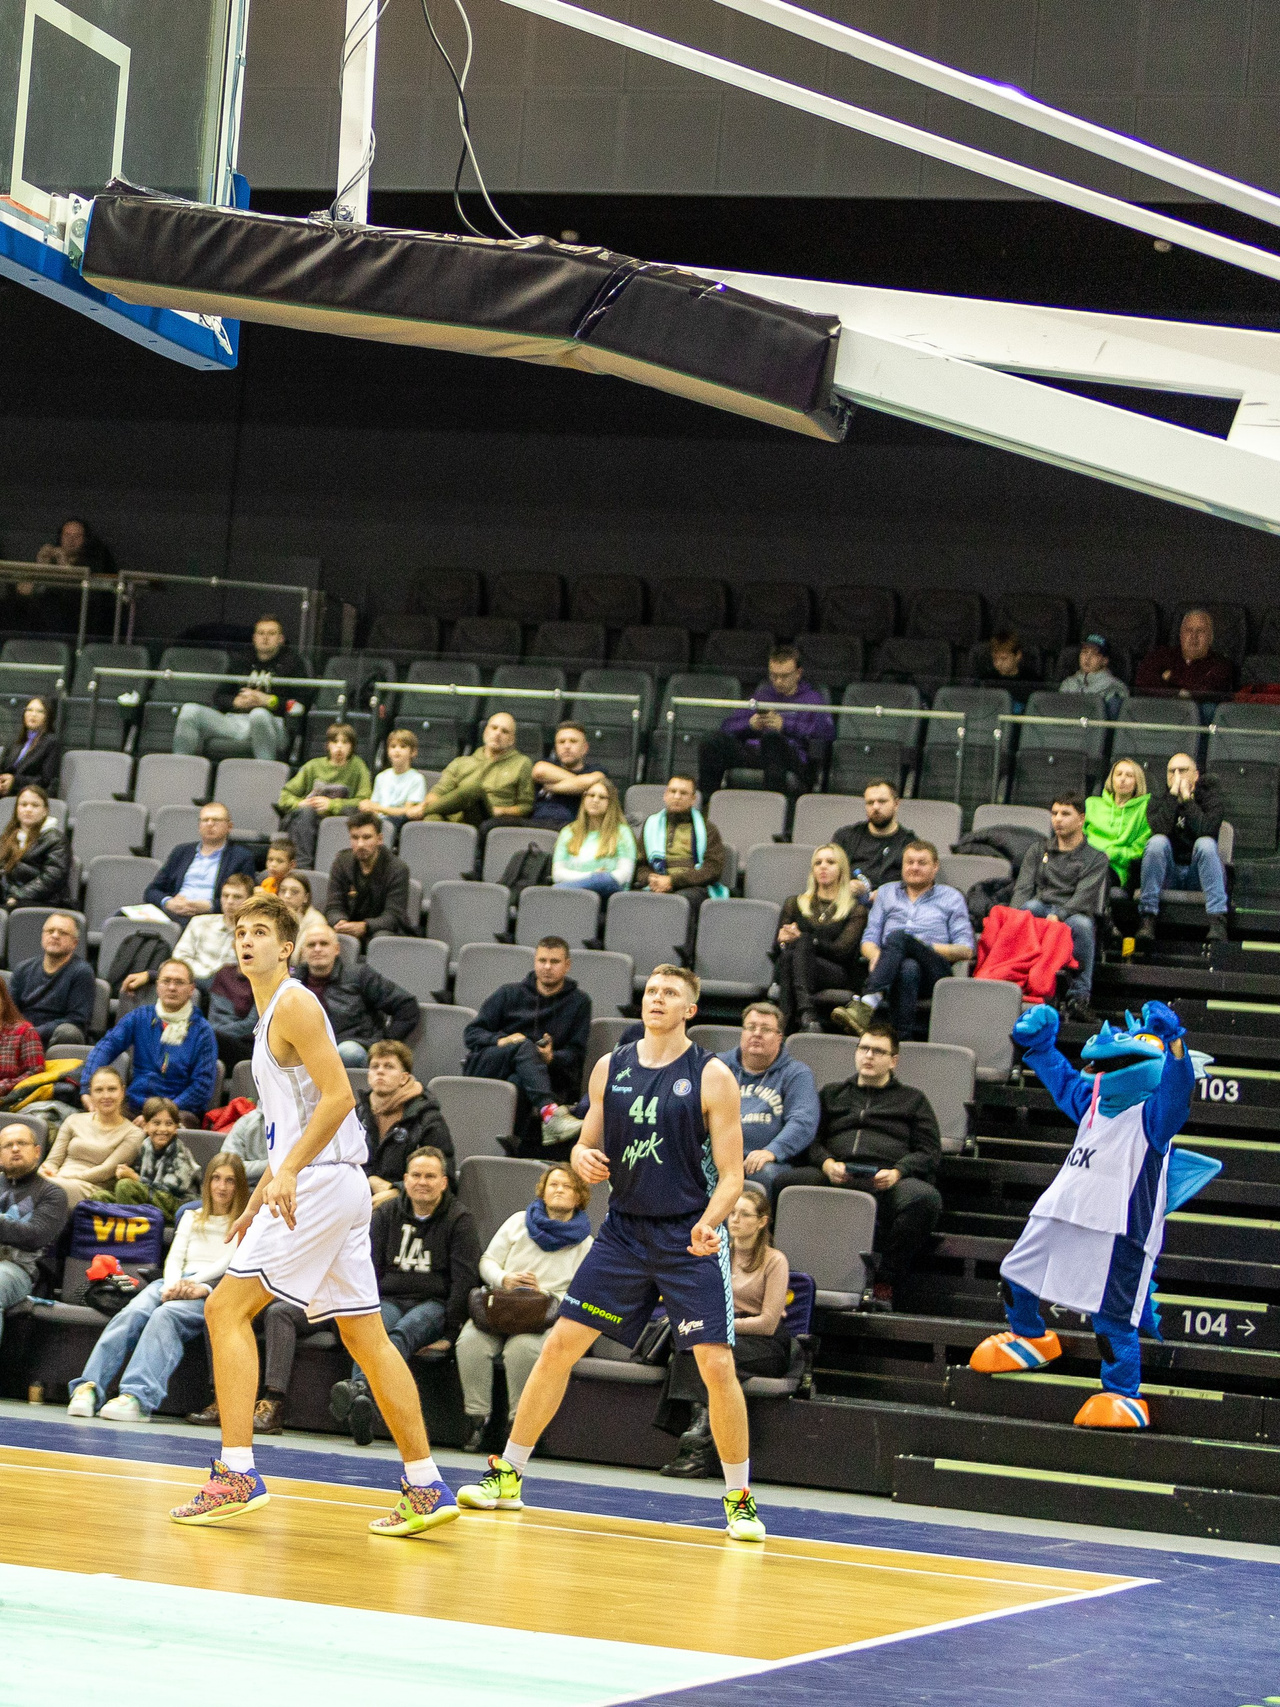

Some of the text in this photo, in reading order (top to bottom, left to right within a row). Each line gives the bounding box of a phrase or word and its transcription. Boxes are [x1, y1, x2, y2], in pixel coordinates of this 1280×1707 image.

[1198, 1078, 1240, 1102] 103
[628, 1095, 659, 1125] 44
[92, 1215, 151, 1242] VIP
[581, 1301, 624, 1324] евроопт
[1182, 1310, 1228, 1337] 104
